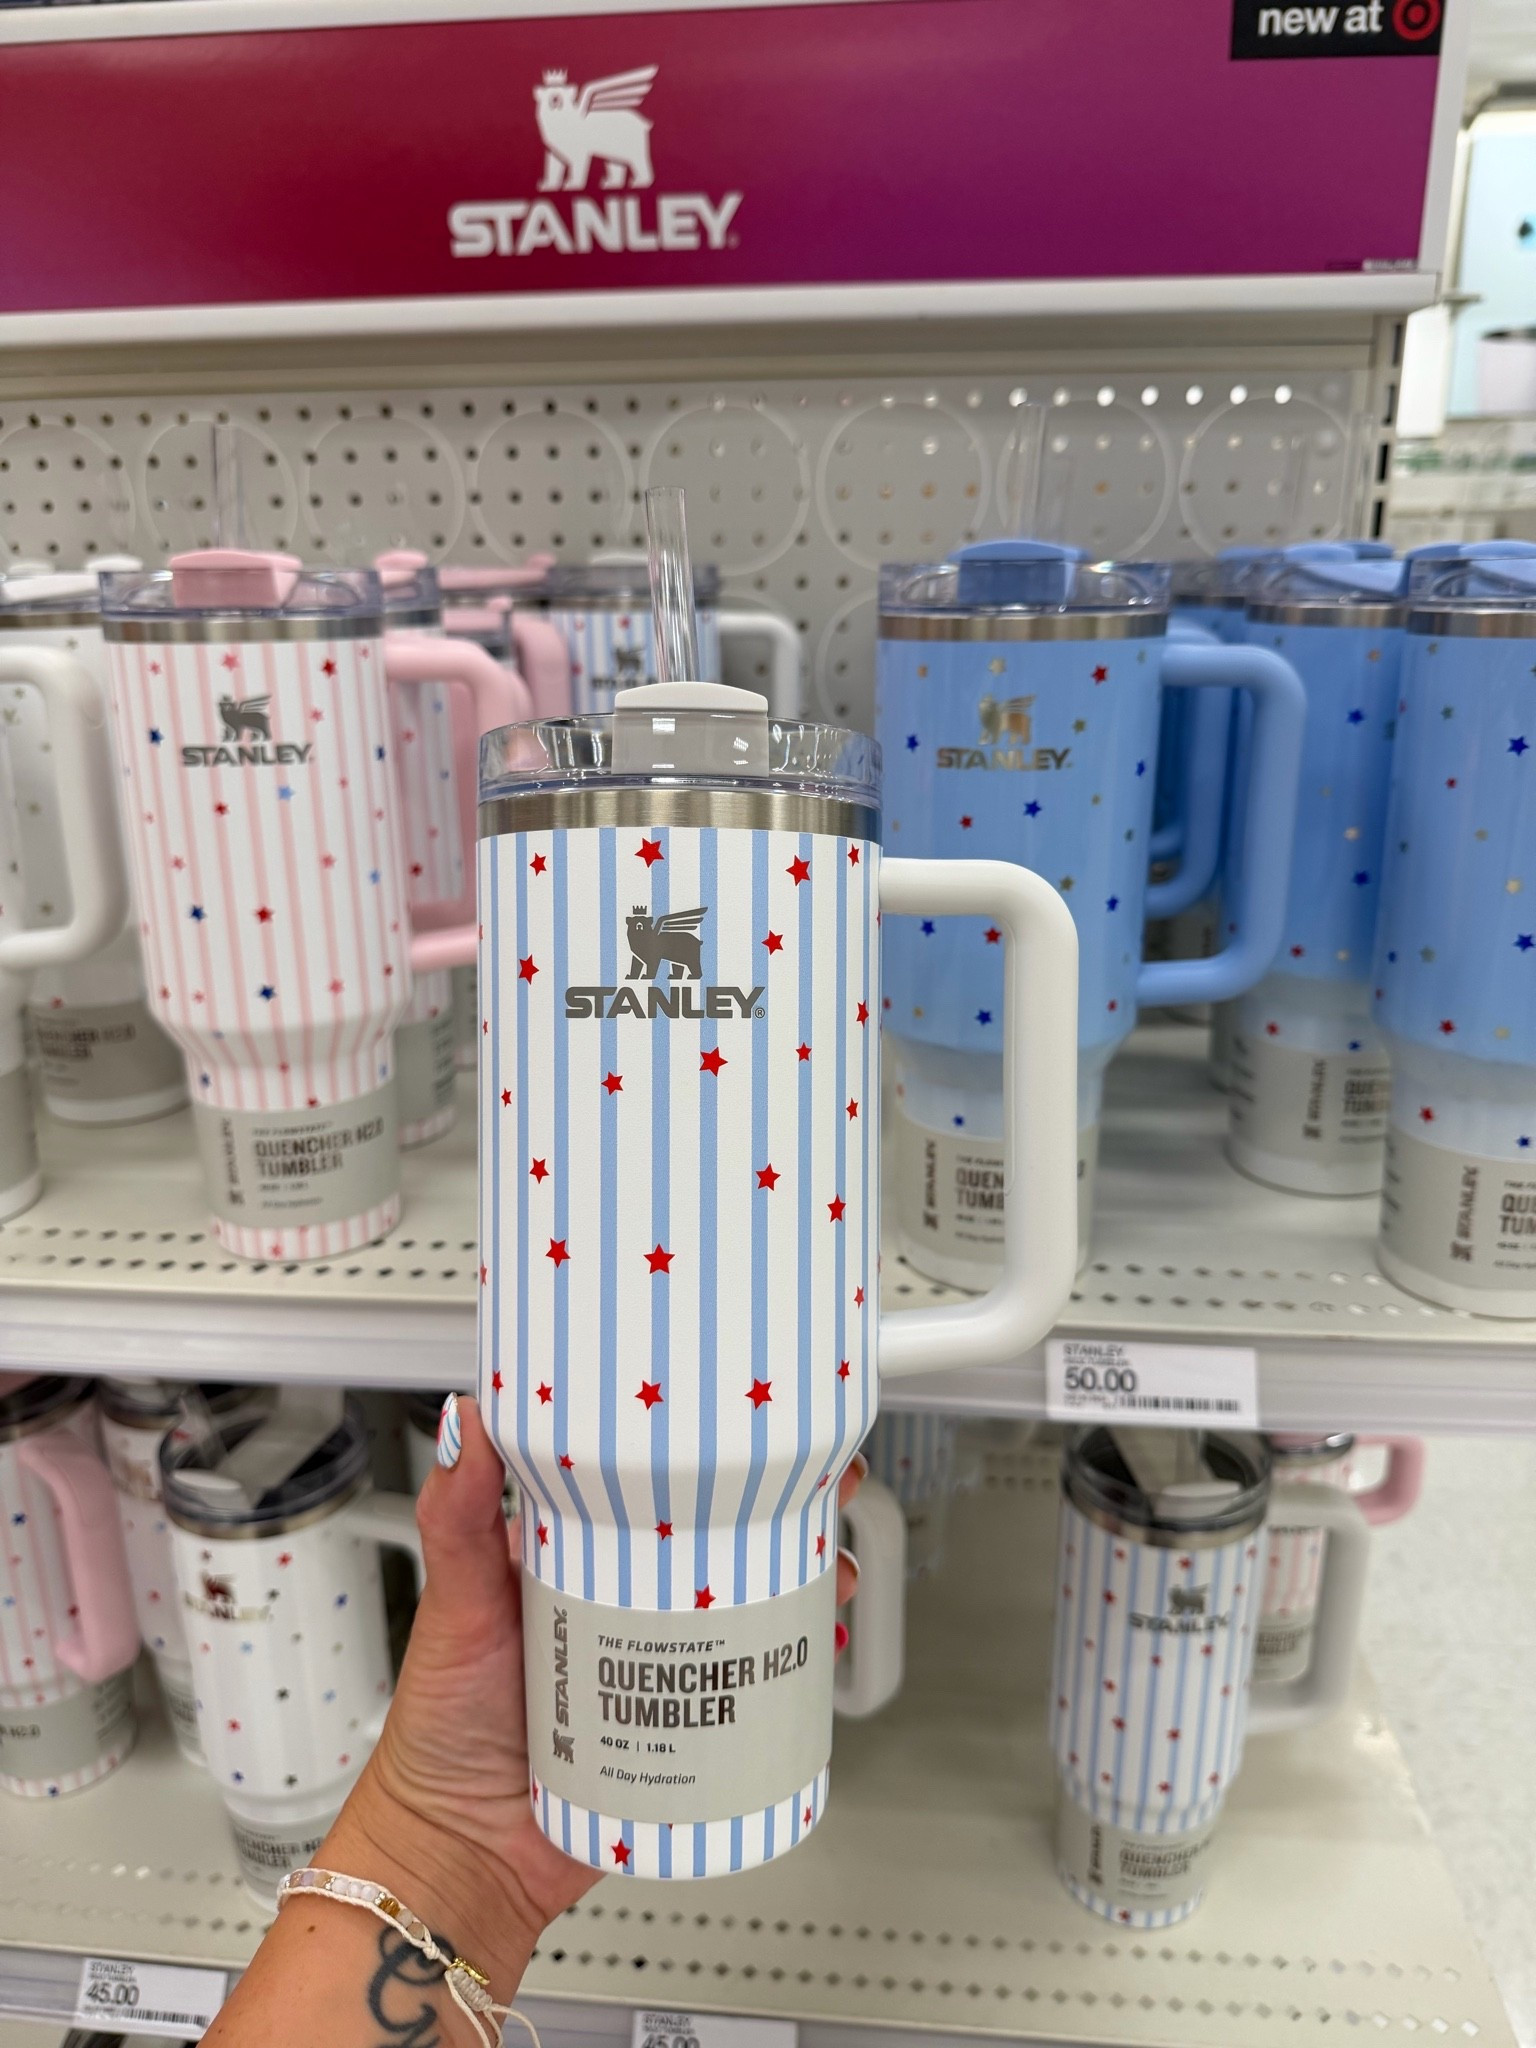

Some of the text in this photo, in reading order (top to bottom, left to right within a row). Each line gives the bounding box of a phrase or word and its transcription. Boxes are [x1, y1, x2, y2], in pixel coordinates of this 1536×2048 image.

[1257, 0, 1384, 36] new at
[1065, 1366, 1137, 1392] 50.00
[598, 1634, 624, 1650] THE
[598, 1635, 809, 1694] QUENCHER H2.0
[597, 1690, 737, 1729] TUMBLER
[600, 1735, 614, 1747] 40
[615, 1738, 630, 1750] OZ
[646, 1742, 667, 1753] 1.18
[669, 1743, 677, 1753] L
[600, 1765, 697, 1786] All Day Hydration
[86, 1980, 140, 2006] 45.00
